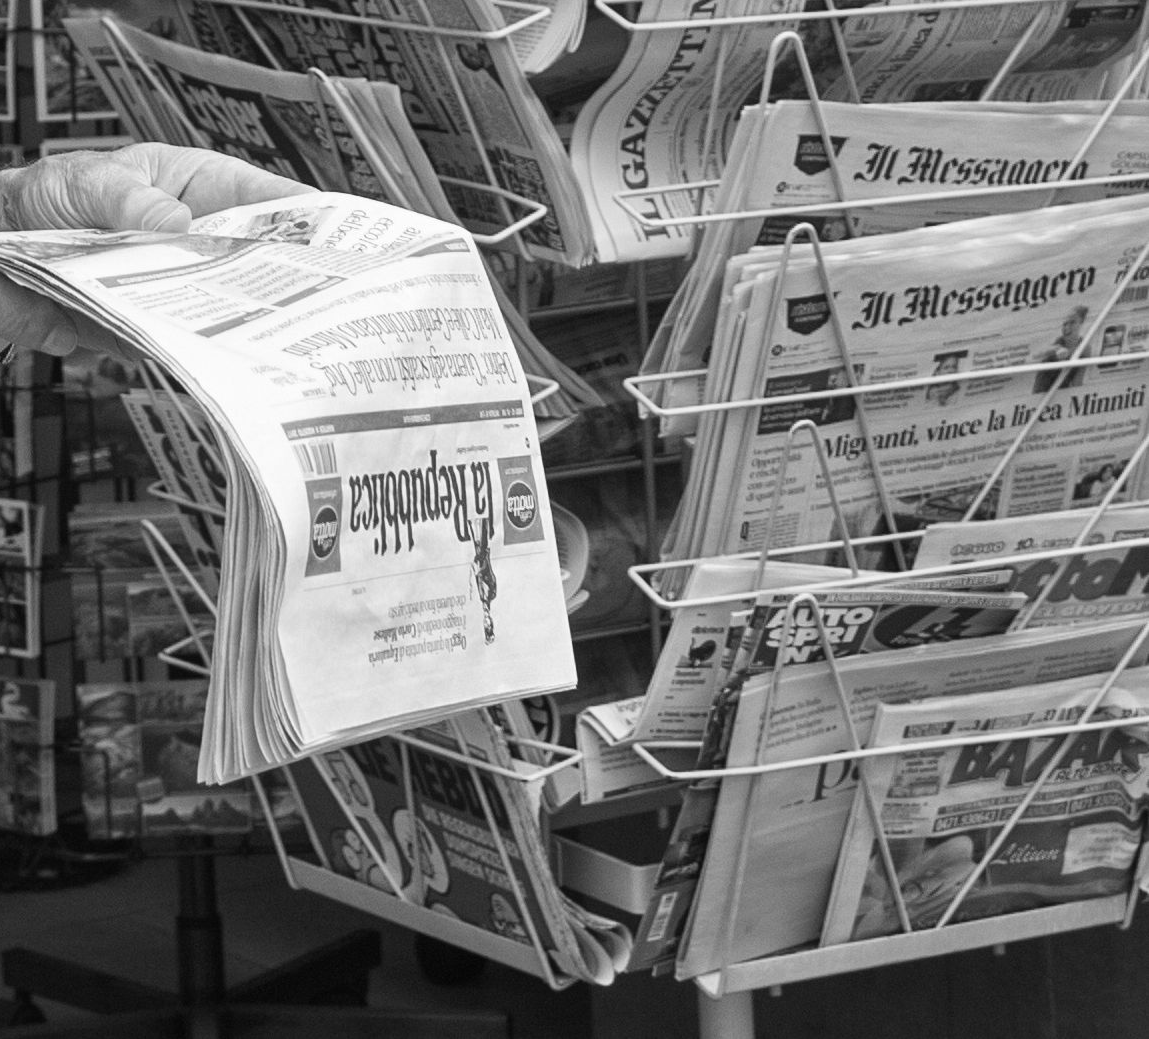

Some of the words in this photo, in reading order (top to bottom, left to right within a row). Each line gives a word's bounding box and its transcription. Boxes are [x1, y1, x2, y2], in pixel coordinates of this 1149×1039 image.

[897, 147, 1089, 189] Messaggero
[897, 267, 1095, 328] Messaggero
[927, 420, 982, 442] vince
[986, 409, 1007, 433] la
[1067, 385, 1147, 418] Minniti
[349, 449, 471, 556] Repubblica
[469, 461, 494, 542] la
[507, 494, 536, 517] motta
[312, 521, 338, 546] motta
[398, 622, 418, 640] Corto
[765, 607, 875, 630] AUTO
[765, 625, 860, 649] SPRI
